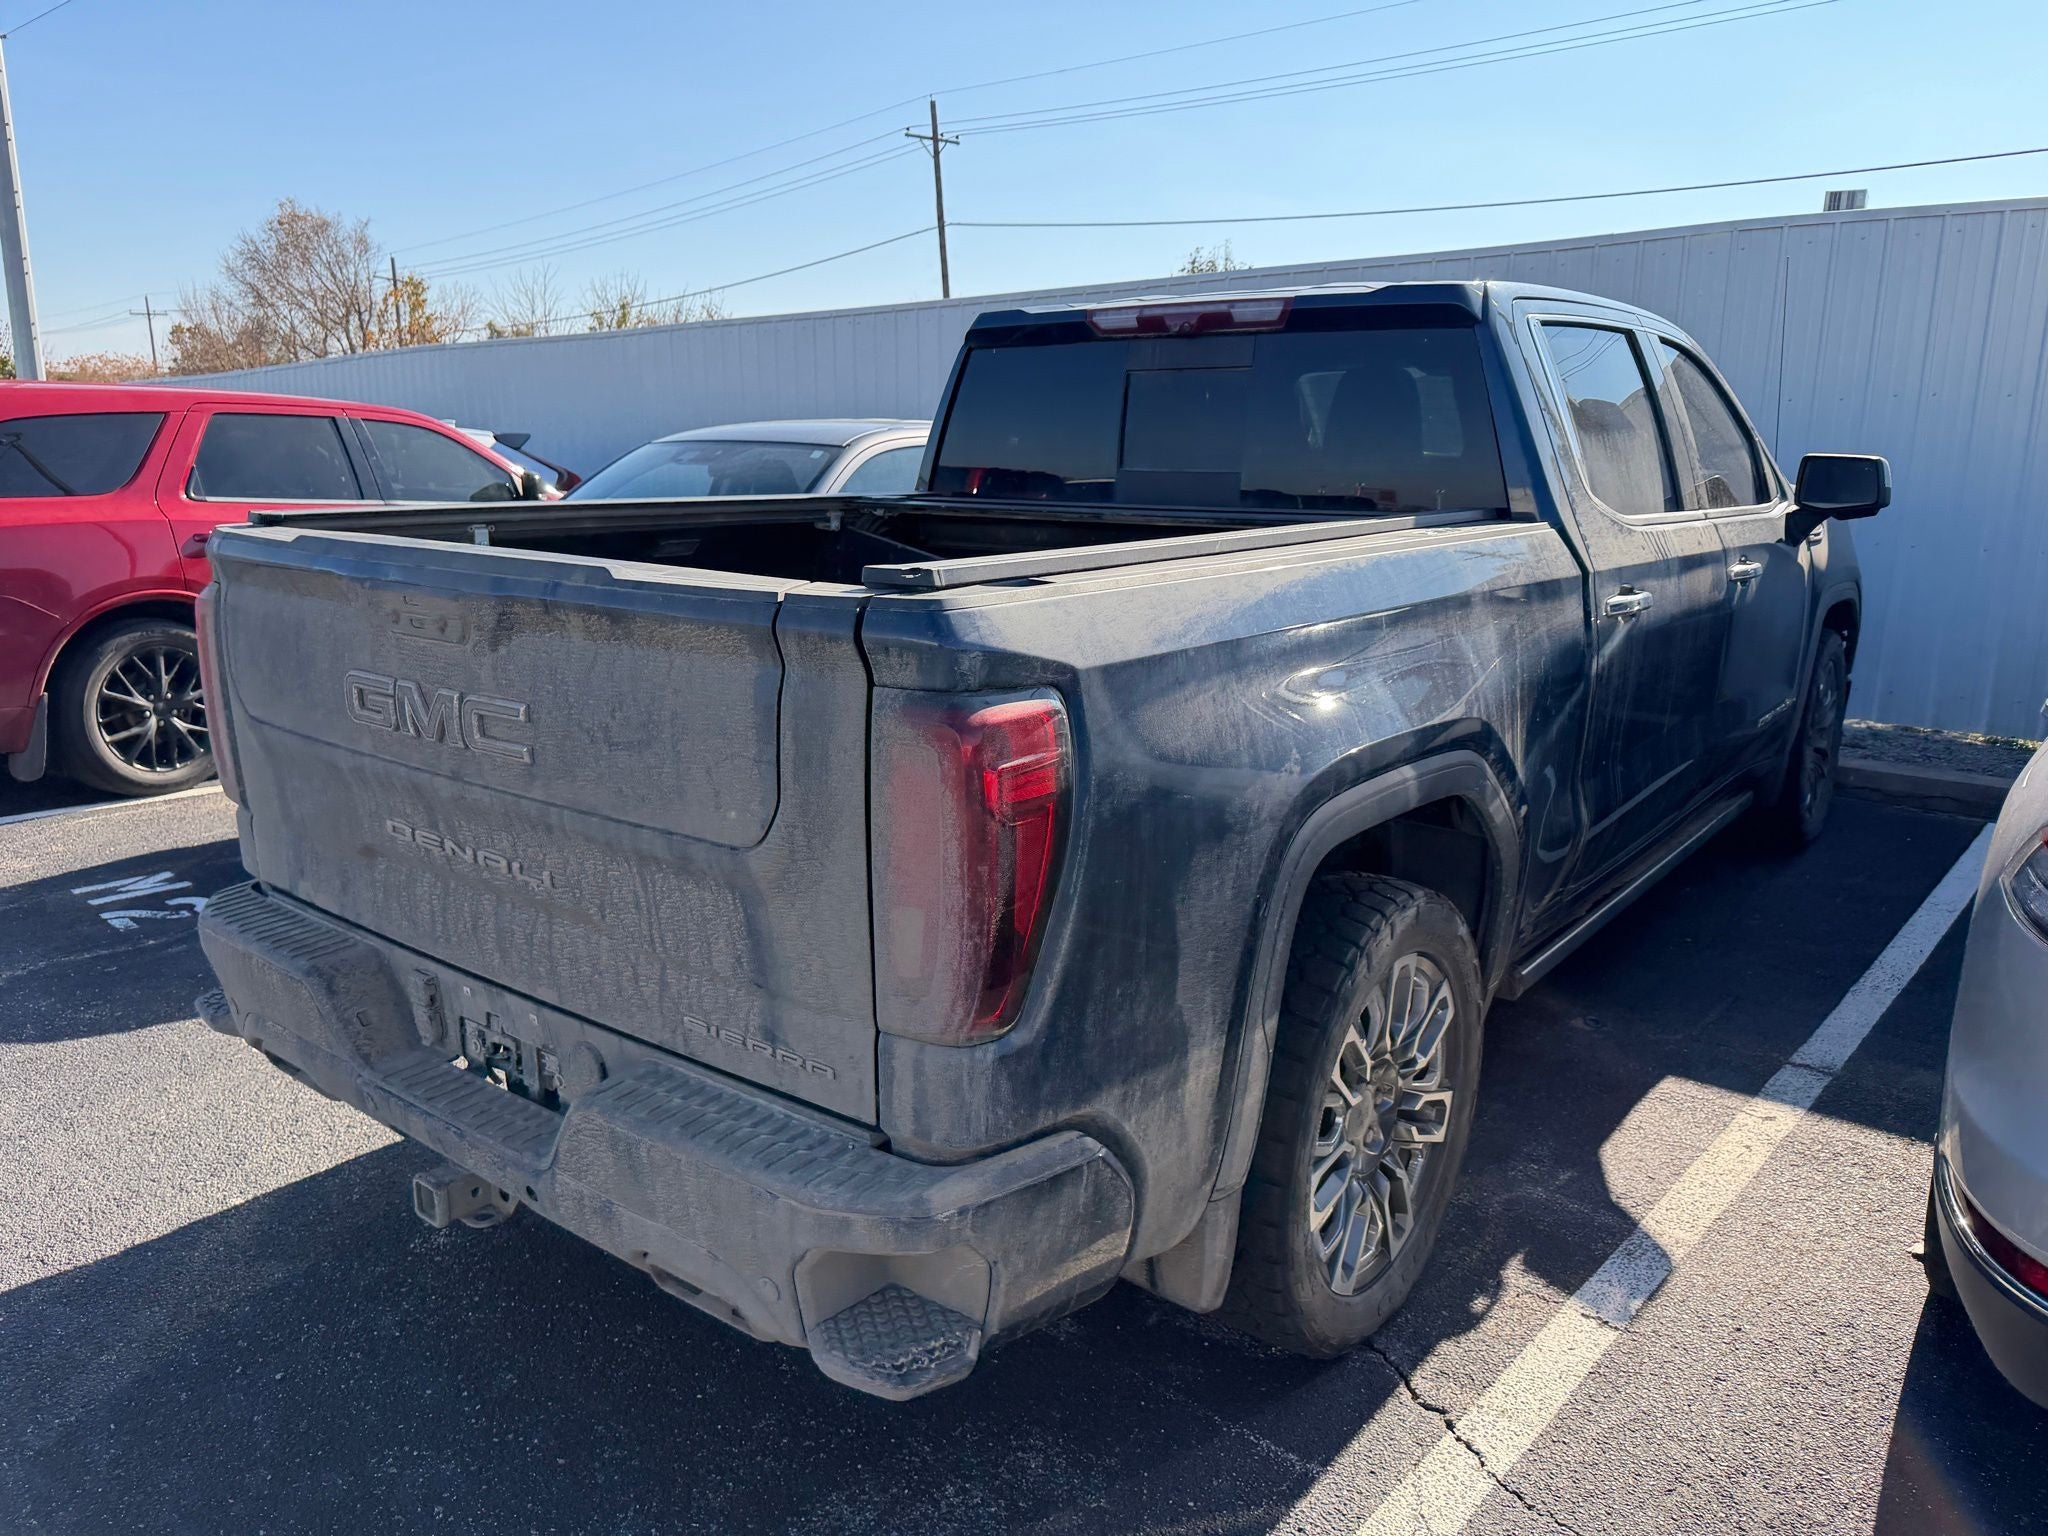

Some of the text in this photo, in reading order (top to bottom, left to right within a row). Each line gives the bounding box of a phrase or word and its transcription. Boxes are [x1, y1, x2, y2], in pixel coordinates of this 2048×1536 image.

[344, 668, 534, 764] GMC
[386, 818, 555, 889] DENALI
[683, 1014, 836, 1080] SIERRA
